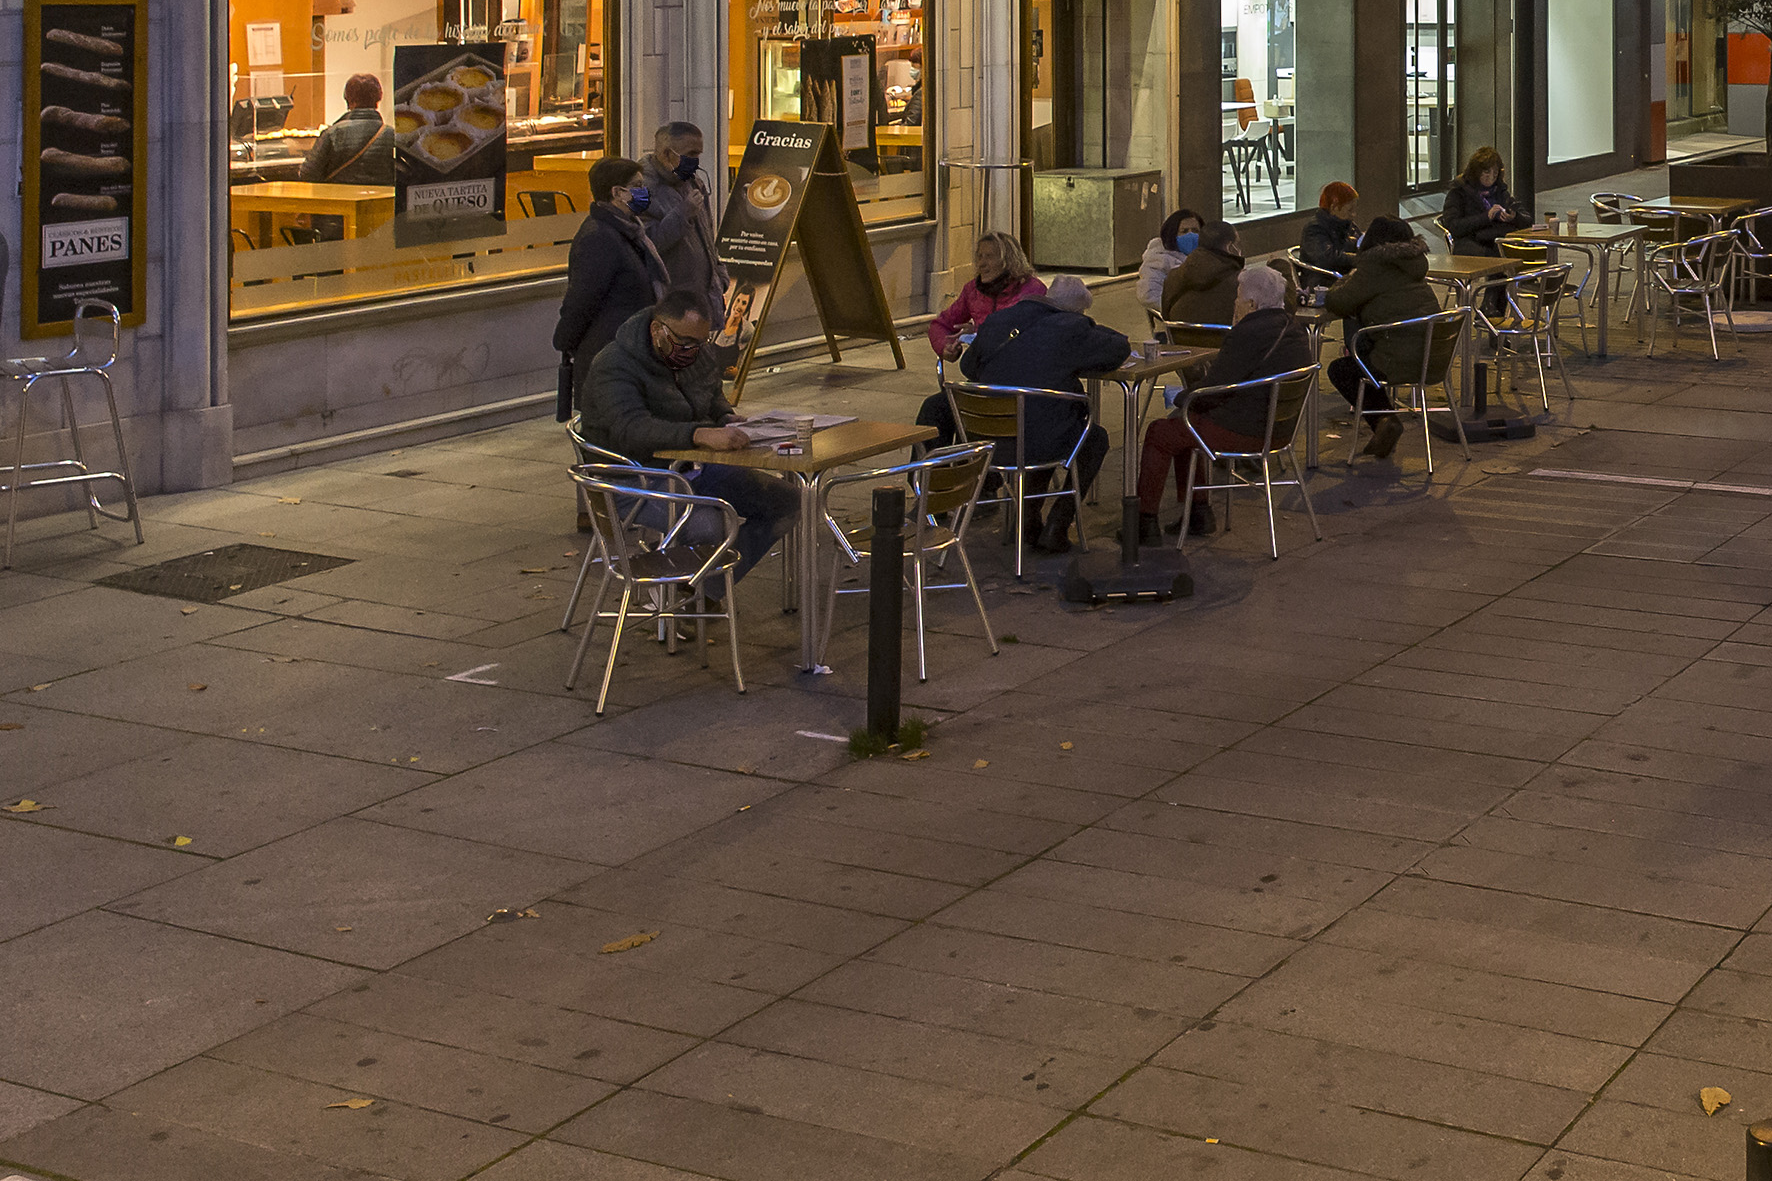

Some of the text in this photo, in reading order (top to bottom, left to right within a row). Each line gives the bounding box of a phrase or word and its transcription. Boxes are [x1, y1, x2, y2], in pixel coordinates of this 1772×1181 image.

[311, 22, 360, 51] Somos
[753, 130, 813, 148] Gracias
[414, 184, 488, 200] NUEVA TARTITA
[432, 194, 488, 214] QUESO
[49, 233, 122, 258] PANES
